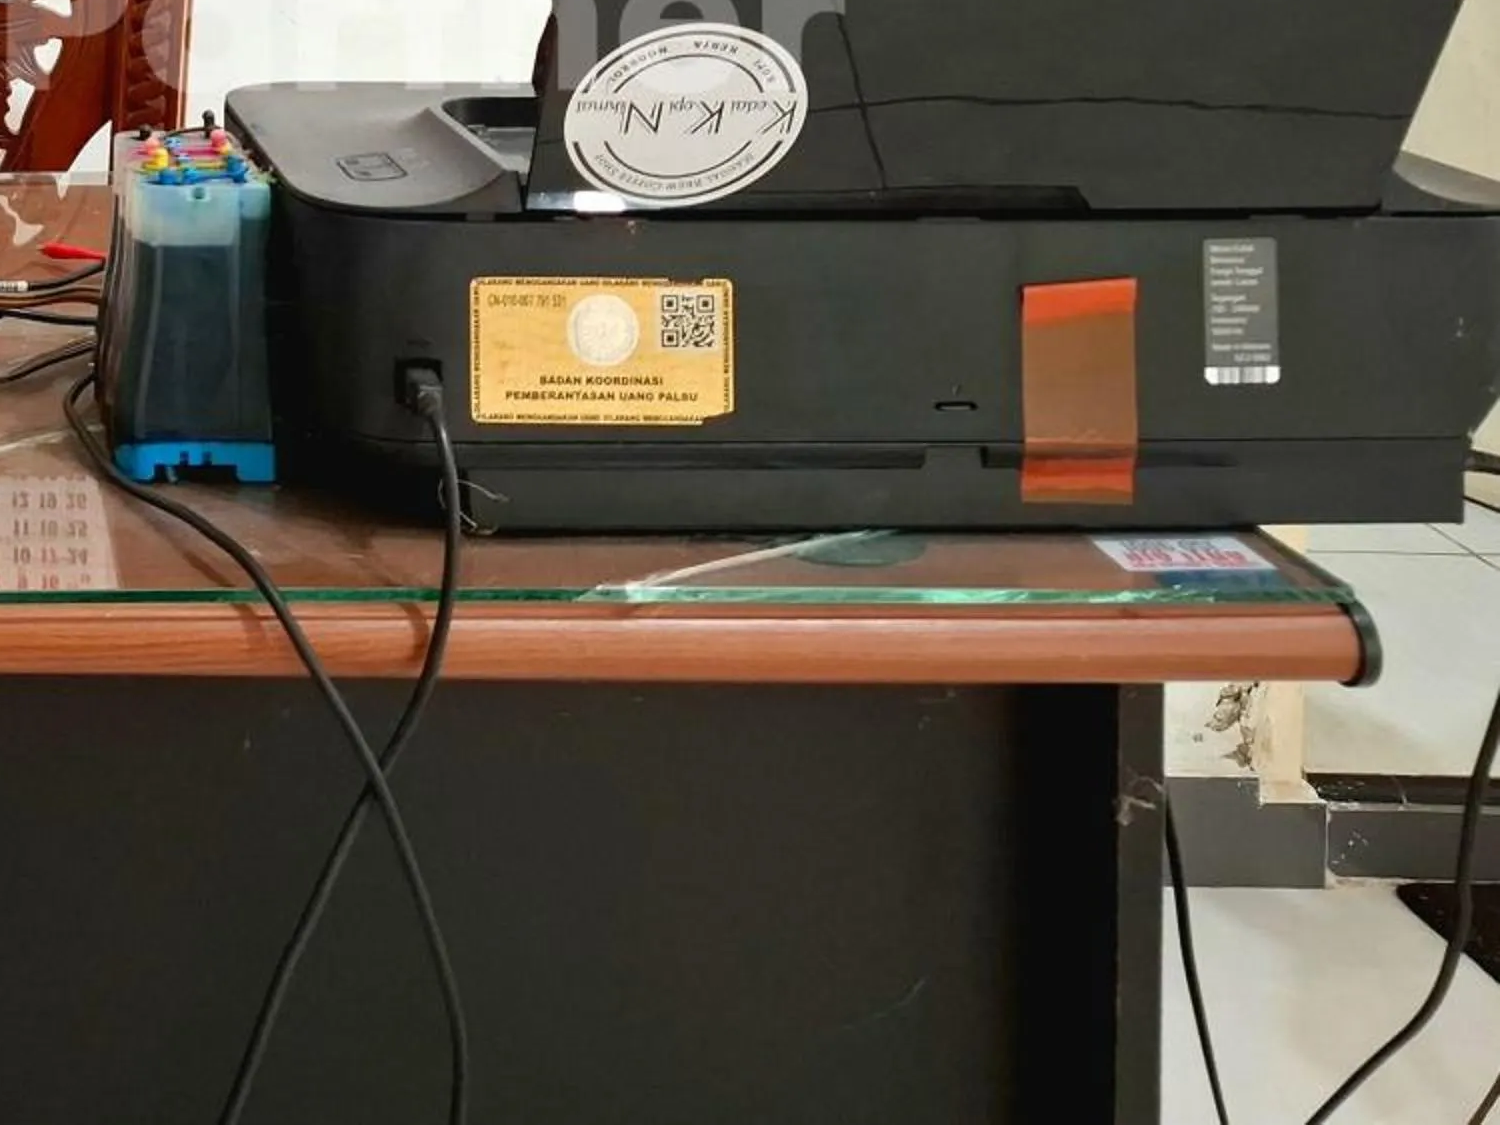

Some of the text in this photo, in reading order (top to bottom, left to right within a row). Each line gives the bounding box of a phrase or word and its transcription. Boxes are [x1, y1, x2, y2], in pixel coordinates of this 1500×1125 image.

[667, 95, 726, 135] Kopi
[730, 99, 798, 135] Kedai
[539, 375, 664, 387] BADAN KOORDINASI
[504, 390, 616, 402] PEMBERANTASAN
[657, 390, 699, 403] PALSU
